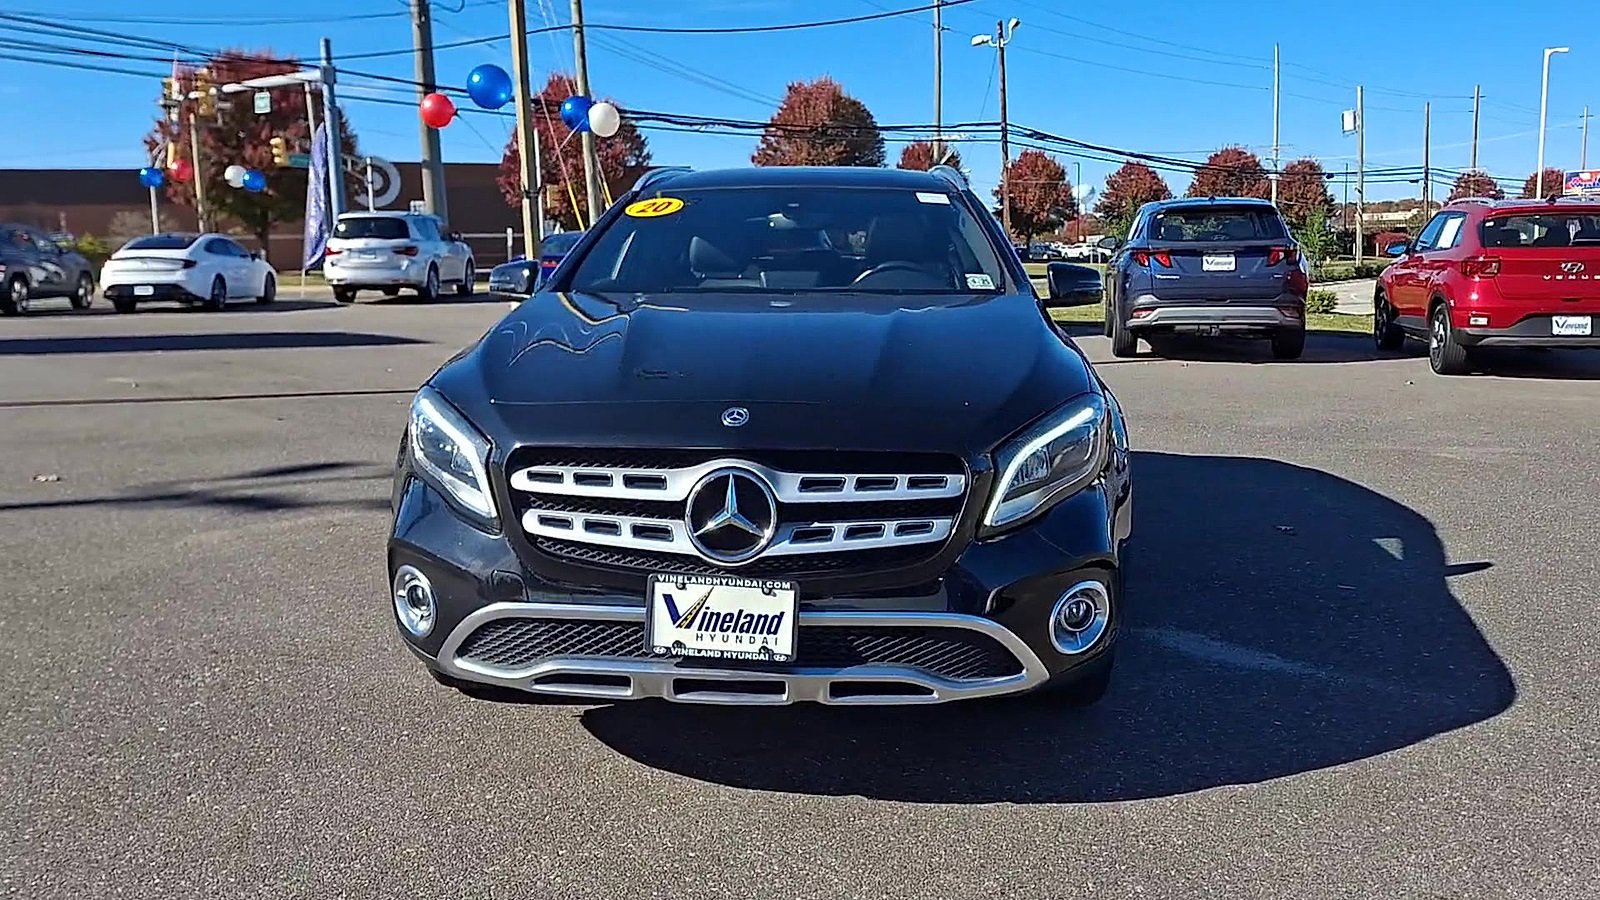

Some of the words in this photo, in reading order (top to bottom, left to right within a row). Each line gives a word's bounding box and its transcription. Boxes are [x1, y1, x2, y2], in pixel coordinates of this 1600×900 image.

[636, 201, 672, 213] 20
[657, 574, 791, 589] VINELANDHYUNDAI.COM
[661, 585, 786, 635] Vineland
[696, 633, 779, 646] HYUNDAI
[670, 647, 722, 659] VINELAND
[724, 650, 769, 661] HYUNDAI
